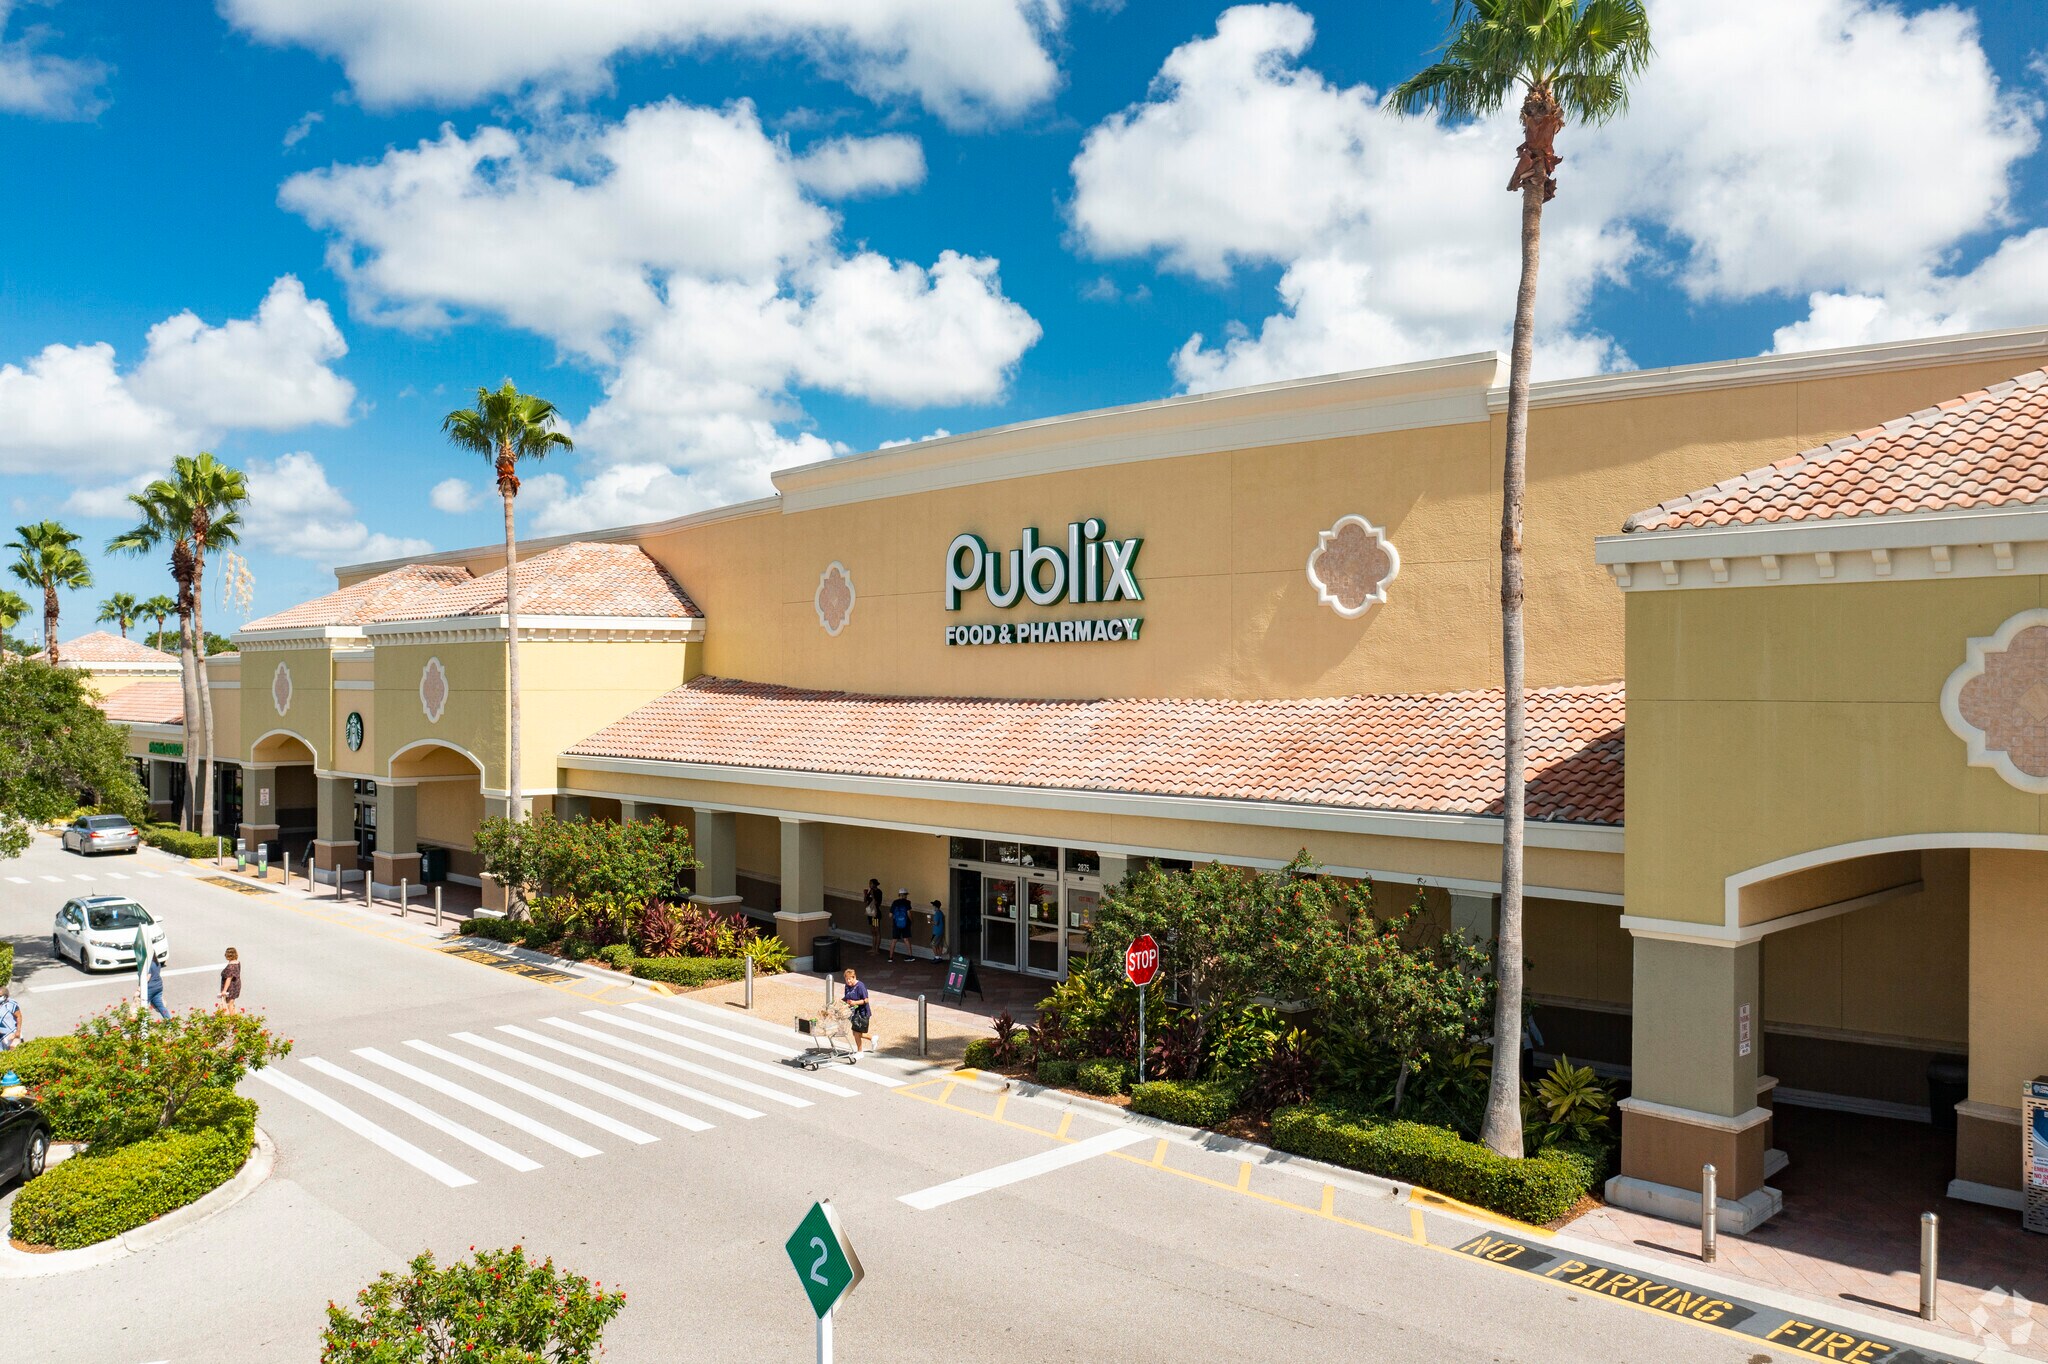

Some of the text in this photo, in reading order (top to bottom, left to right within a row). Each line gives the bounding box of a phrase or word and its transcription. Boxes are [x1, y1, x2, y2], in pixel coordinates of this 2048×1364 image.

[945, 517, 1145, 611] Publix
[945, 618, 1144, 646] FOOD & PHARMACY
[1078, 863, 1090, 872] 2875
[1128, 949, 1157, 971] STOP
[809, 1236, 829, 1286] 2
[1459, 1236, 1891, 1364] NO PARKING FIRE
